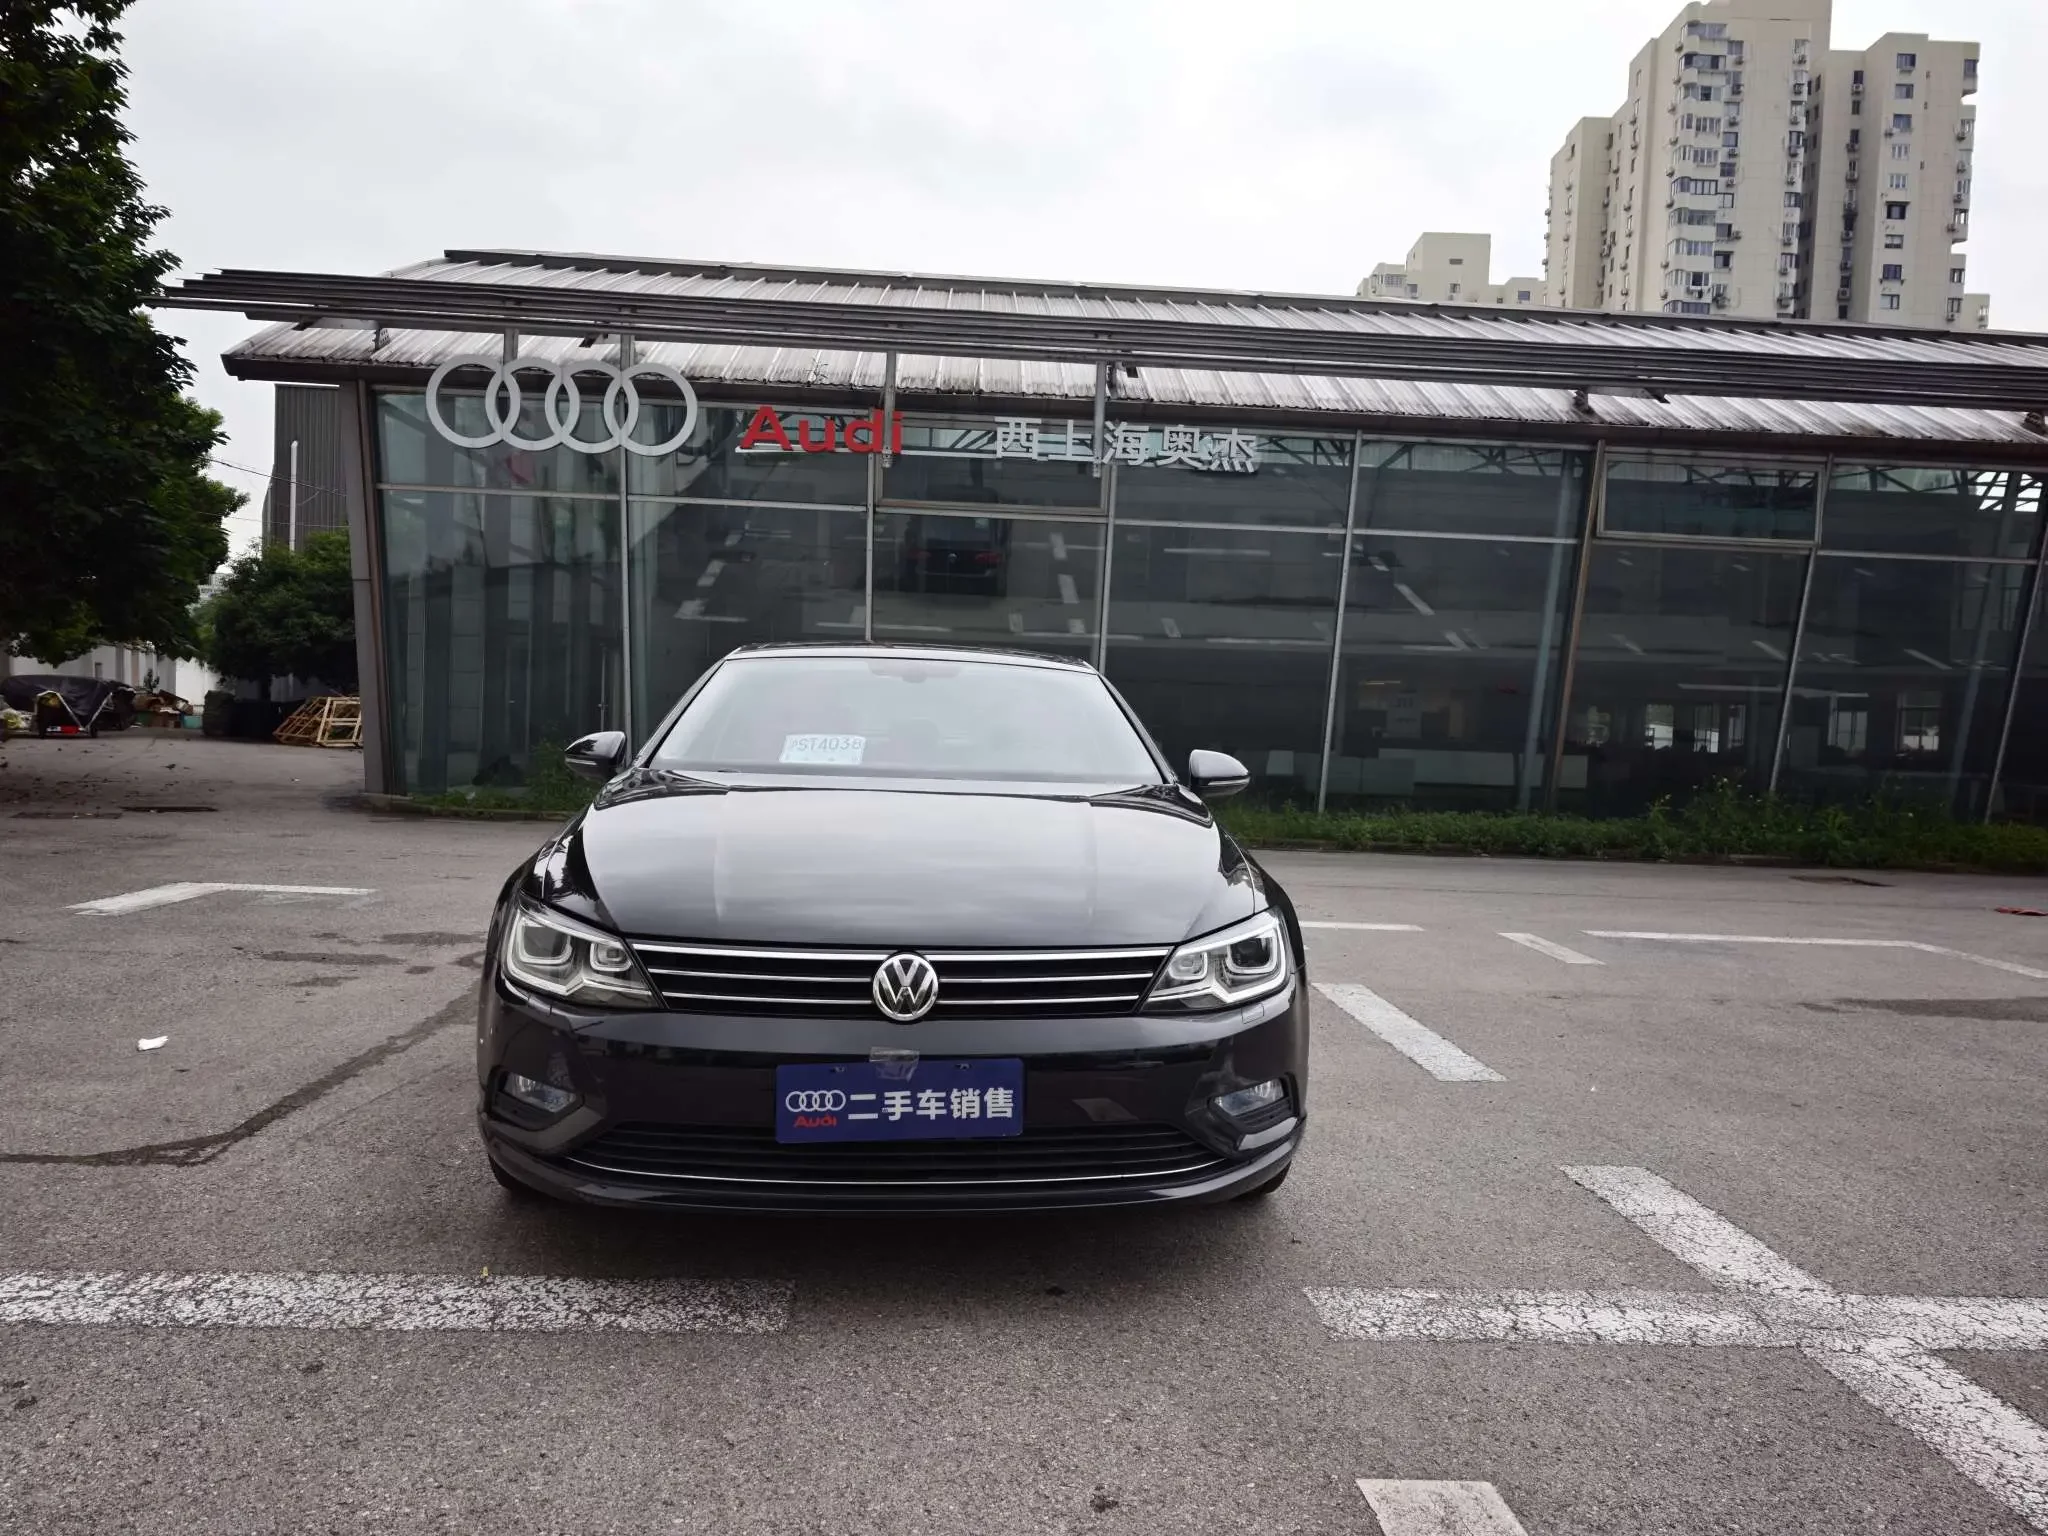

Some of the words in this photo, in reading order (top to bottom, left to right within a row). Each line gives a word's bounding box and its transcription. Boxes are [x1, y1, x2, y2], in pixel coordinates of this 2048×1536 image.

[740, 404, 903, 454] Audi
[994, 416, 1257, 472] 西上海奥杰
[793, 1113, 837, 1128] Audi
[847, 1087, 1014, 1121] 二手车销售
